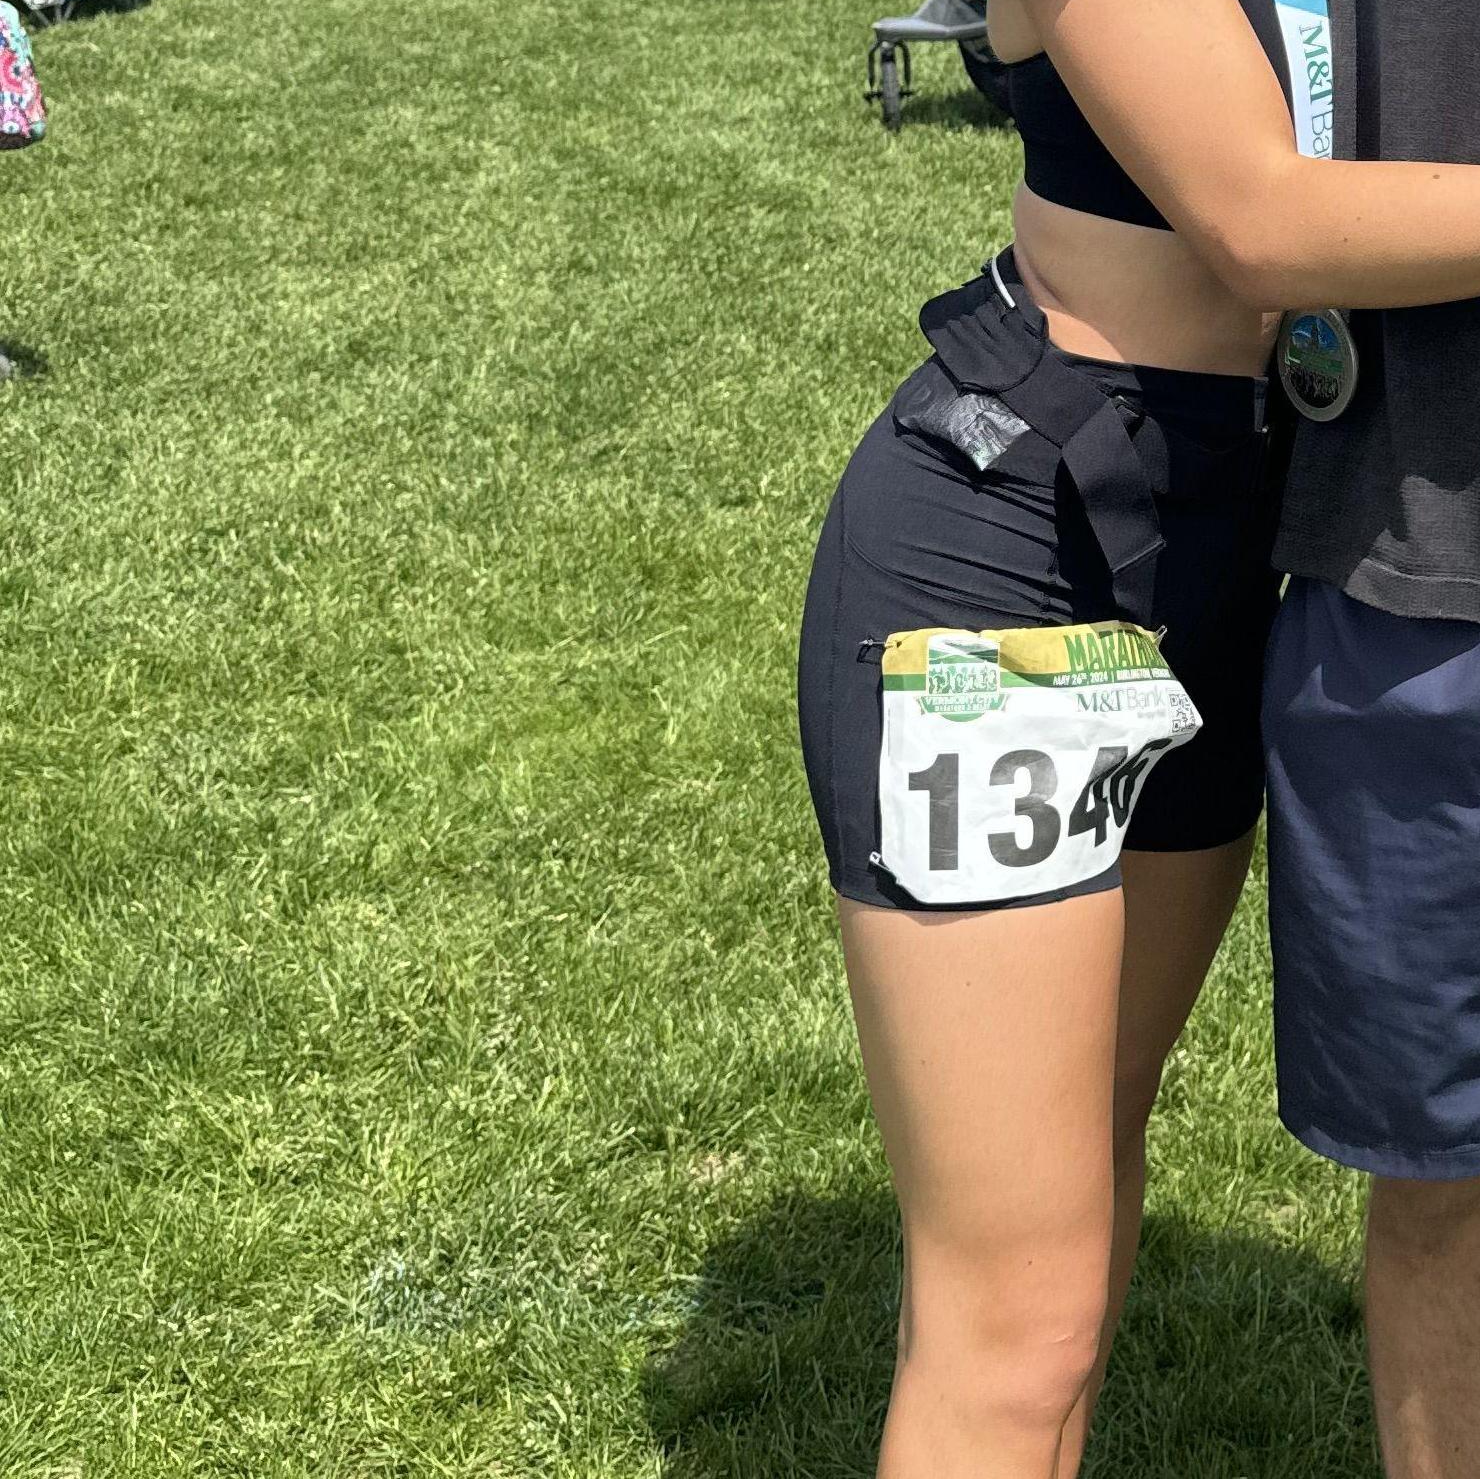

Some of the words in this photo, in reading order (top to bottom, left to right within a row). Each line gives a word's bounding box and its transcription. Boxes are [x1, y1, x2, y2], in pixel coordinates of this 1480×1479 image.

[1298, 21, 1334, 106] M&T
[1311, 110, 1334, 160] Ba
[1090, 670, 1109, 682] 2024
[1076, 688, 1123, 712] M&T
[1126, 684, 1166, 710] Bank
